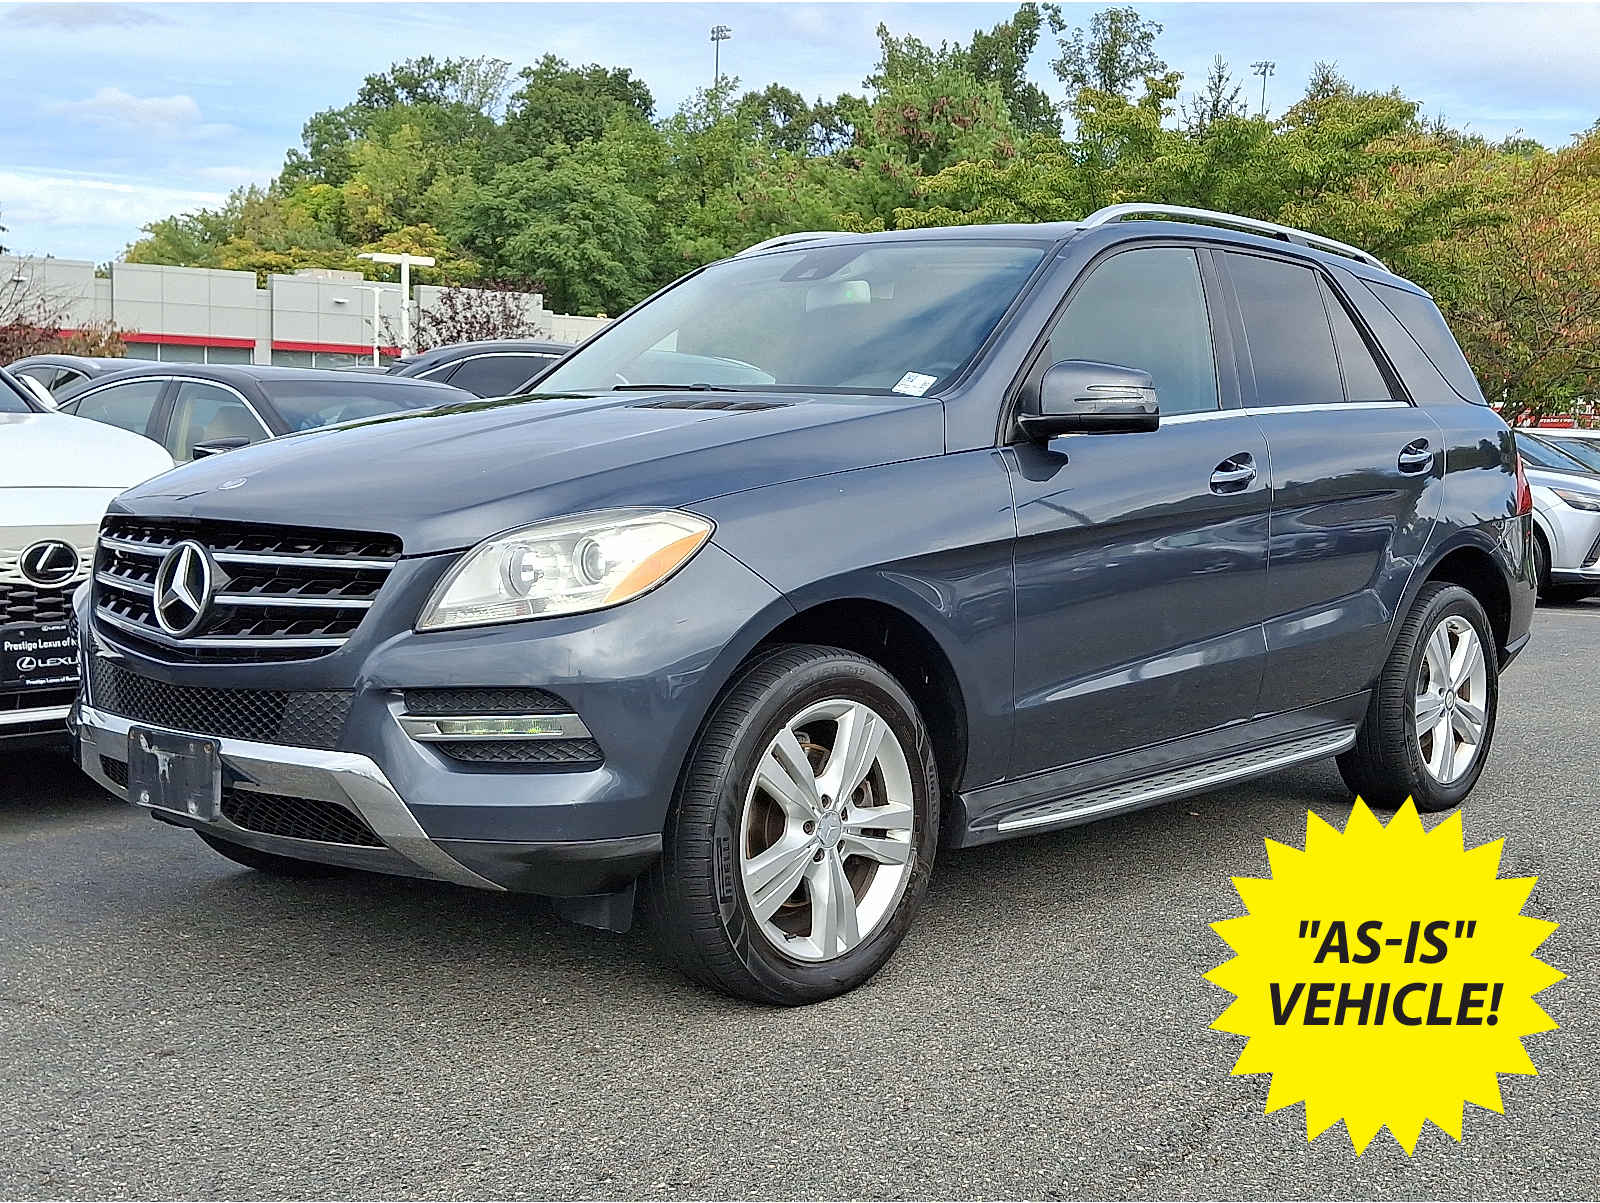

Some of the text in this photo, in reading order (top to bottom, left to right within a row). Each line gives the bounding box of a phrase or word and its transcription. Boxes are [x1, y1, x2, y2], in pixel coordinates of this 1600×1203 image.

[4, 641, 37, 651] Prestige
[38, 639, 61, 648] Lexus
[62, 637, 70, 647] of
[38, 657, 79, 667] LEXU
